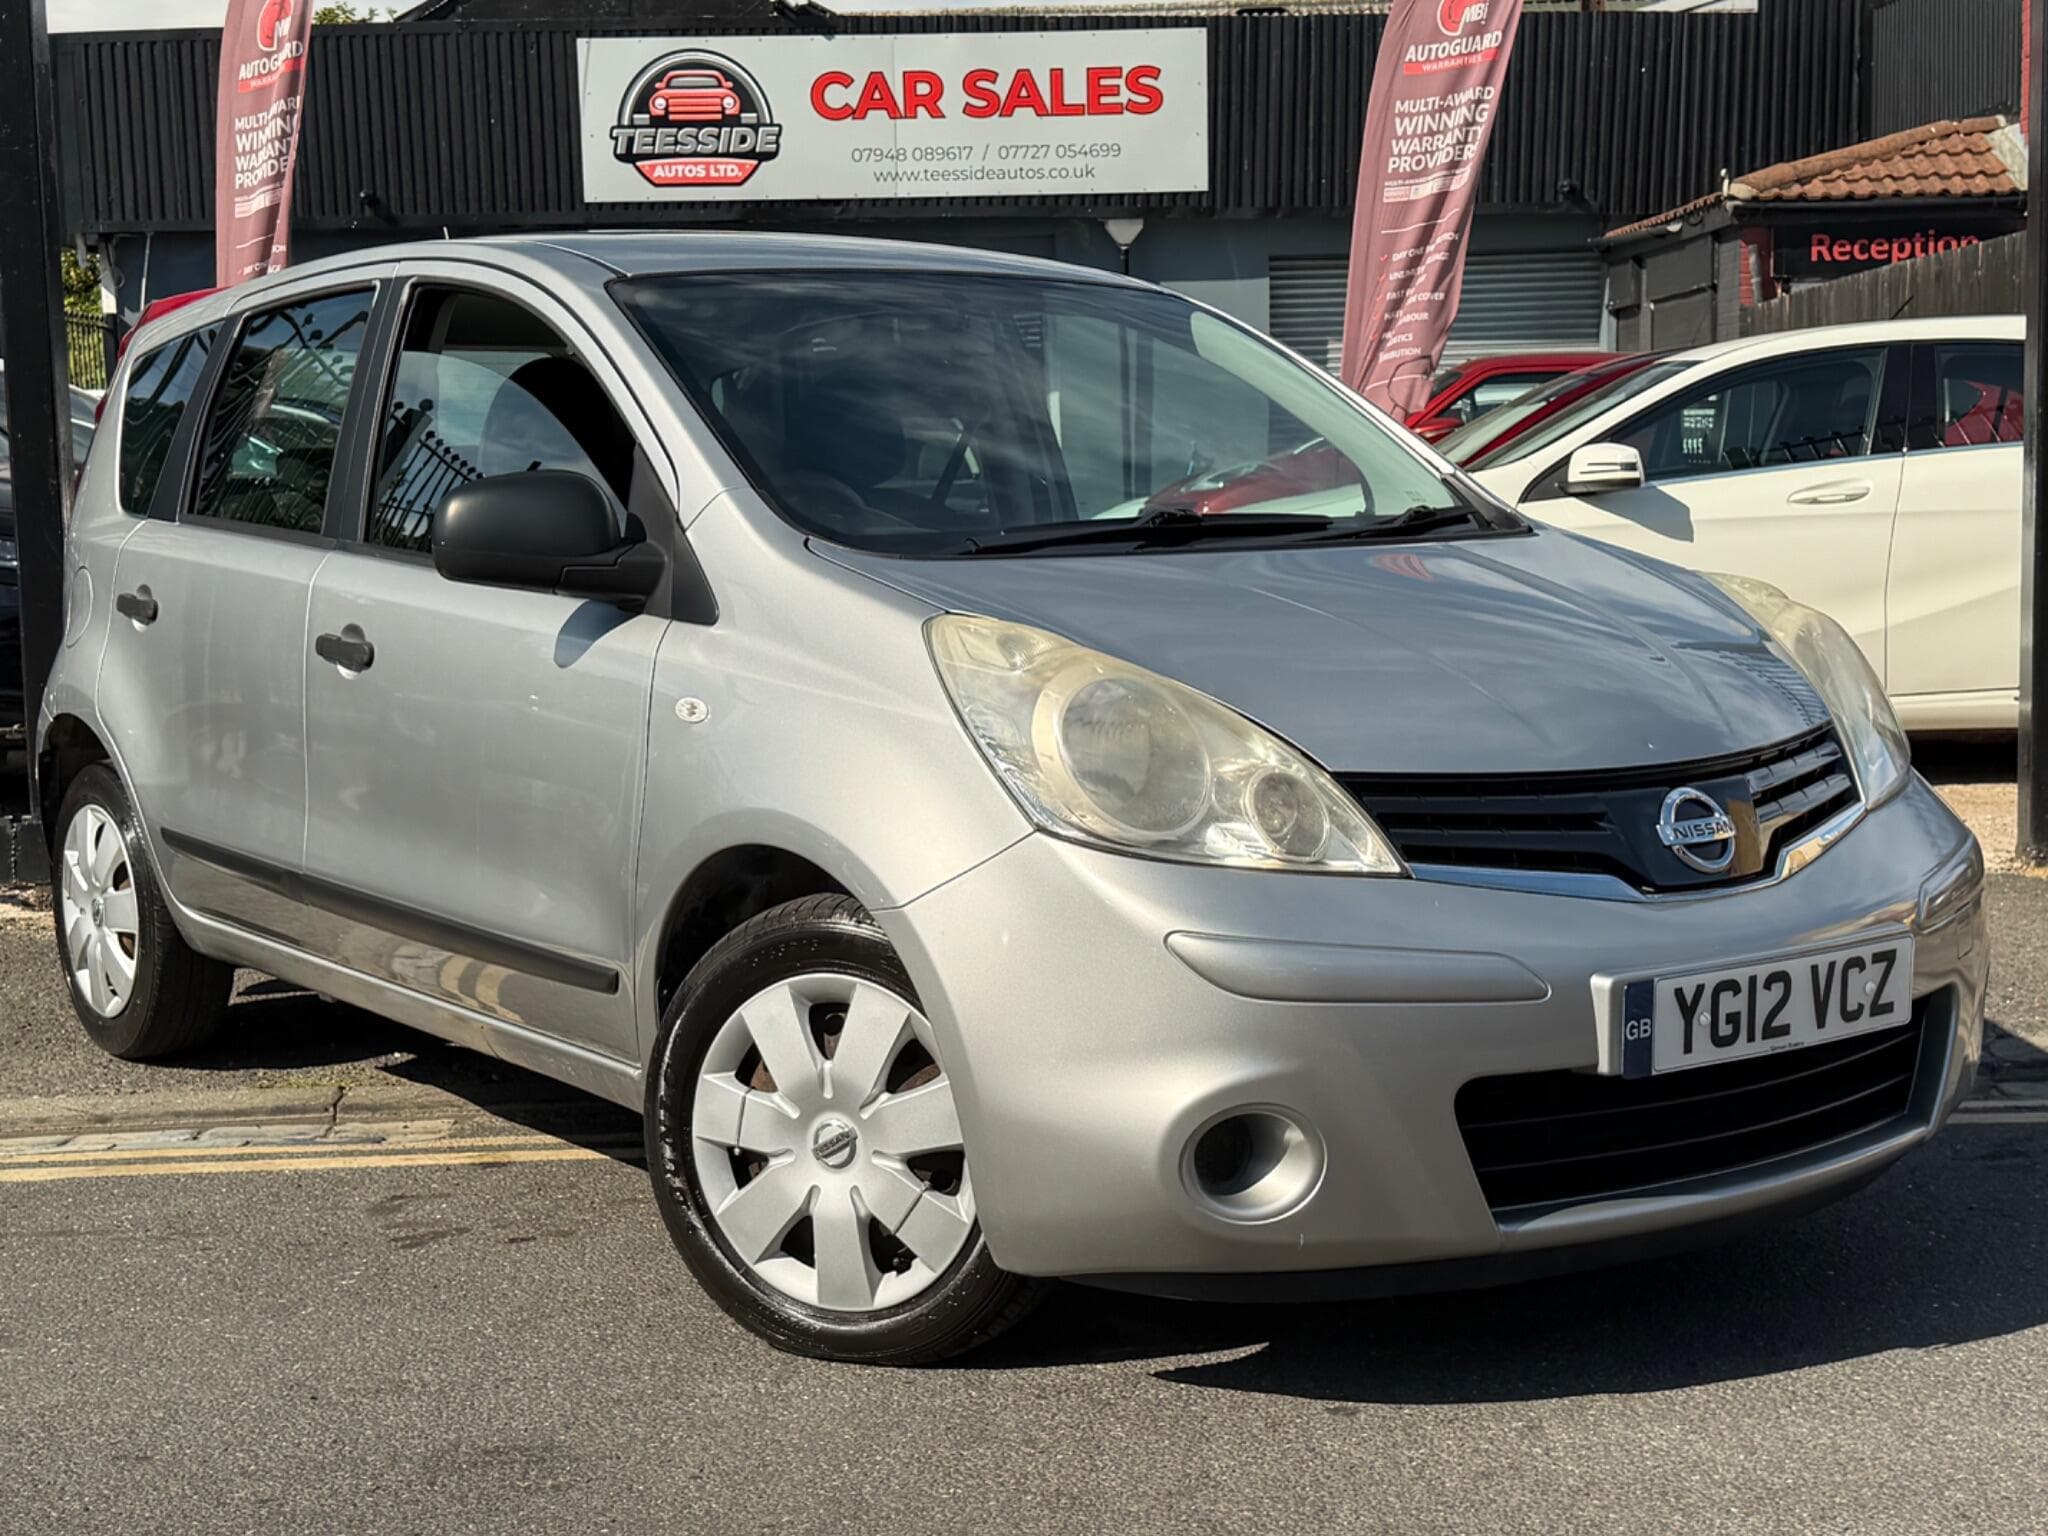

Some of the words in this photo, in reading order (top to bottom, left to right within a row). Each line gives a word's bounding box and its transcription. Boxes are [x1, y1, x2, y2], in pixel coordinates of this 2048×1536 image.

[239, 40, 304, 80] AUTOGRD
[1405, 30, 1502, 62] AUTOGUARD
[810, 71, 945, 120] CAR
[962, 65, 1164, 118] SALES
[1395, 86, 1495, 113] MULTI-AWARD
[1394, 103, 1490, 137] WINNING
[612, 126, 780, 155] TEESSIDE
[851, 148, 908, 164] 07948
[912, 146, 974, 162] 089617
[982, 144, 990, 161] /
[998, 145, 1050, 161] 07727
[1055, 143, 1122, 160] 054699
[1391, 125, 1486, 155] WARRANTY
[653, 164, 706, 178] AUTOS
[710, 163, 742, 177] LTD.
[873, 164, 1096, 183] www.teessideautos.co.uk
[1673, 818, 1734, 839] NISSAN
[1674, 970, 1792, 1055] YG12
[1810, 949, 1898, 1030] VCZ
[1625, 1018, 1652, 1041] GB
